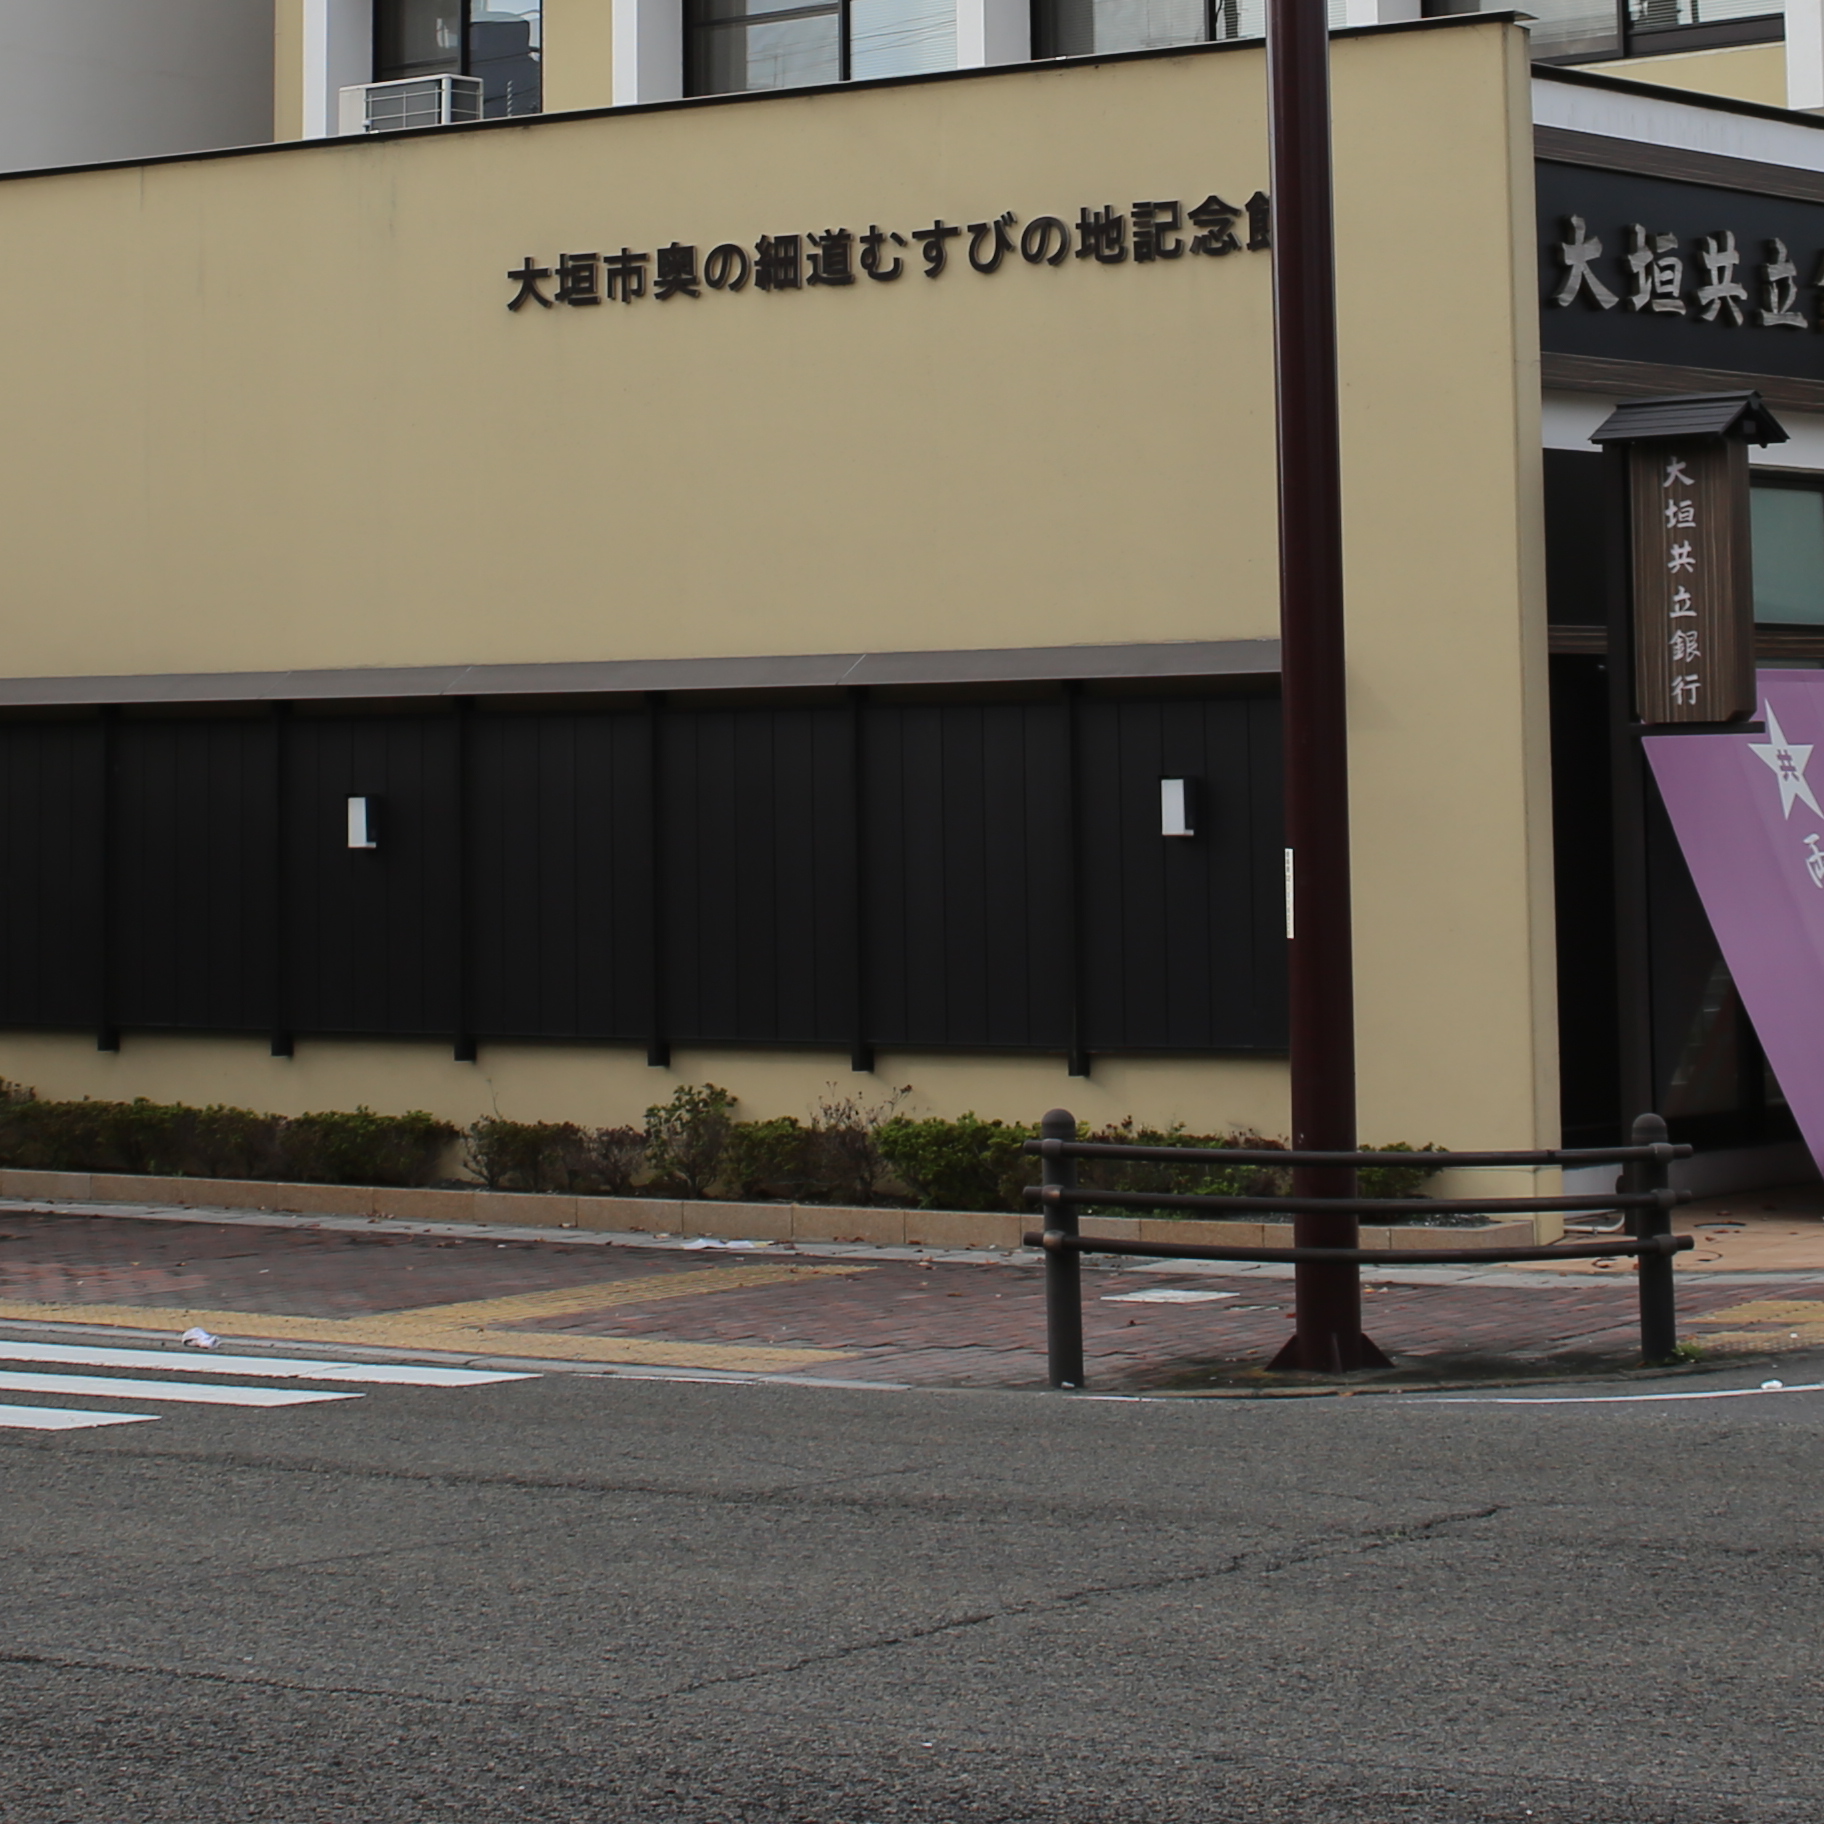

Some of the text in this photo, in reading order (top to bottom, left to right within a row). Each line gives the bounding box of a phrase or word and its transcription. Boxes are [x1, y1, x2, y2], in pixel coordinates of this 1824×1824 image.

[1662, 455, 1703, 707] 大垣共立銀行
